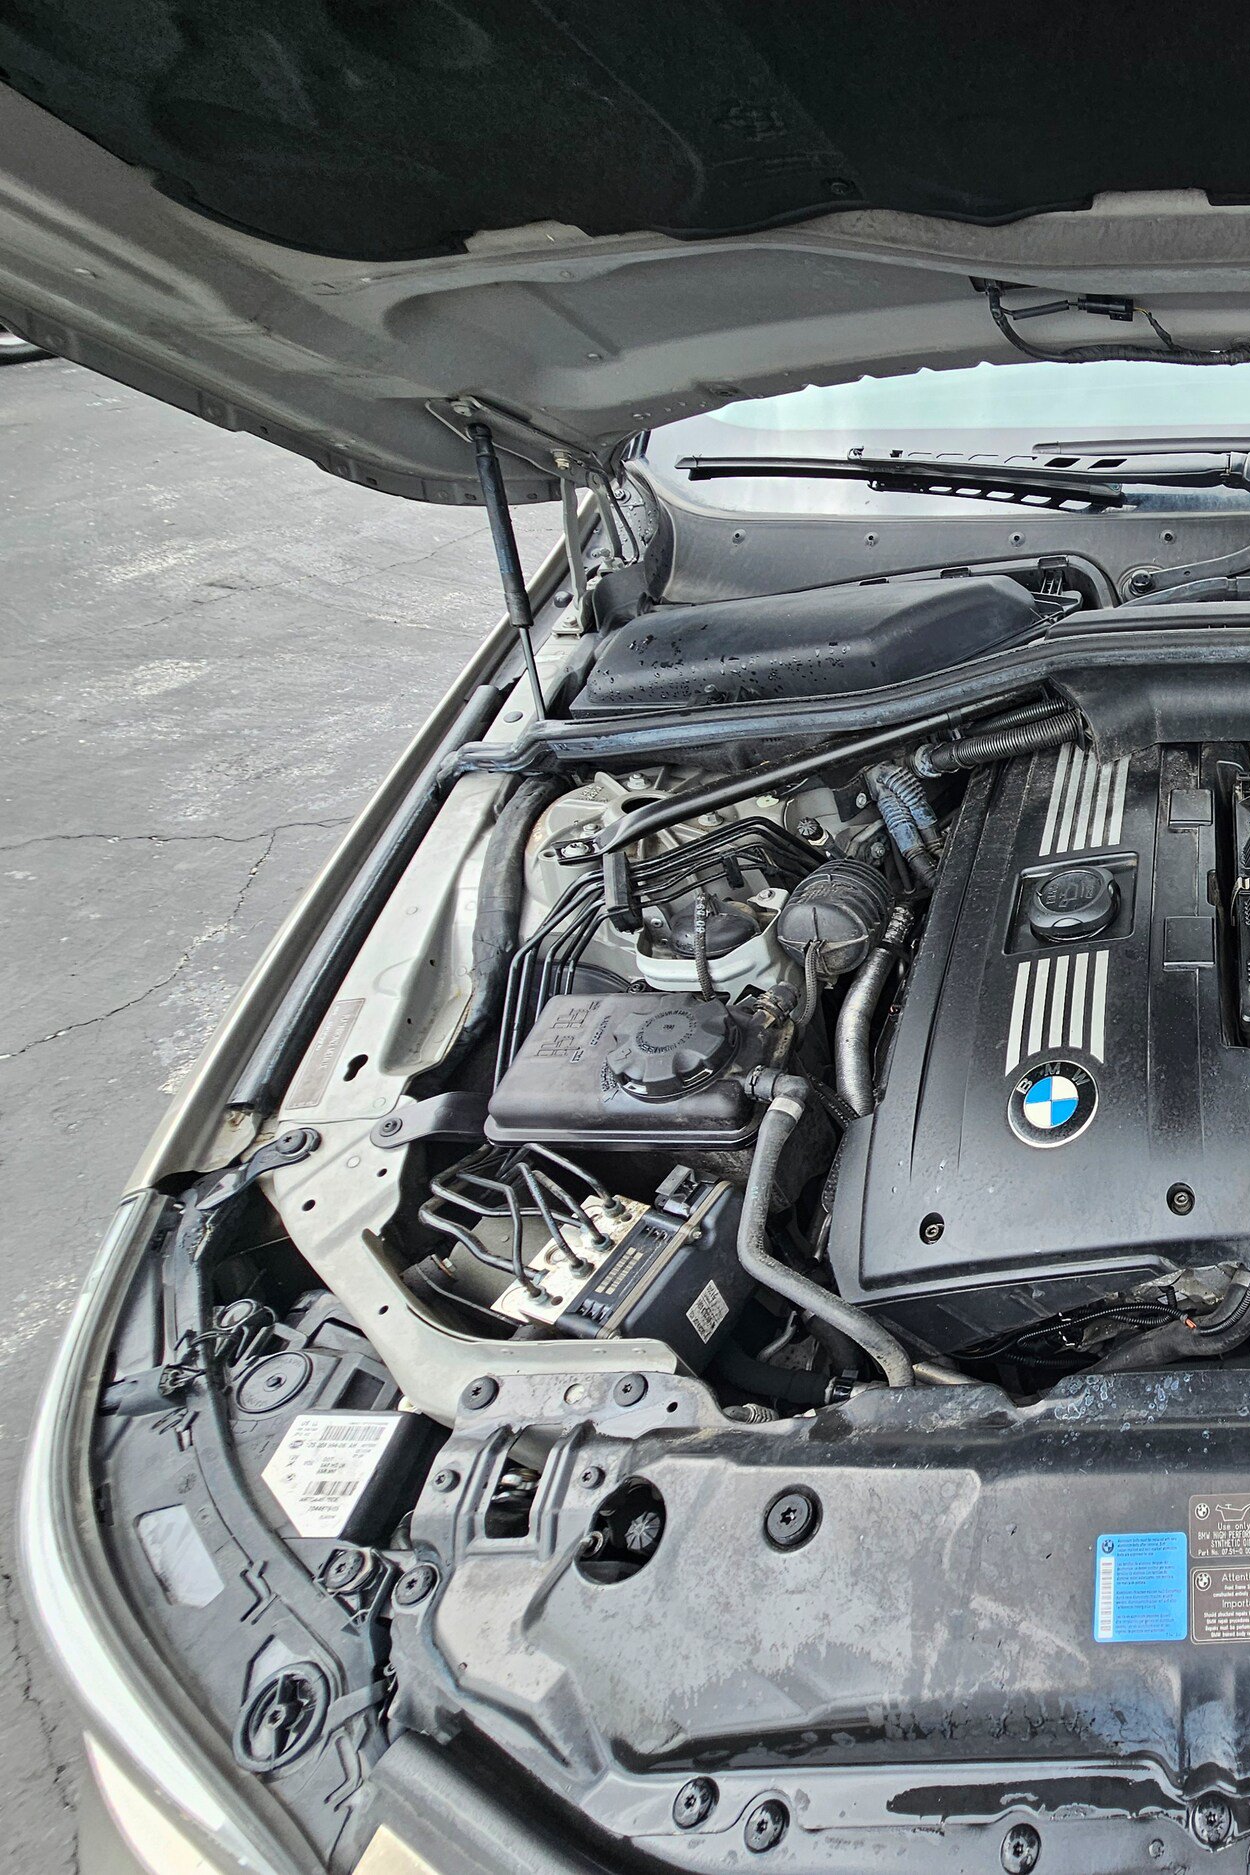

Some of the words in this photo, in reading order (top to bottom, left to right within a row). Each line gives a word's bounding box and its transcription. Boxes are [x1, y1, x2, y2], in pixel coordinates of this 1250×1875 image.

[1016, 1063, 1090, 1095] BMW
[1235, 1521, 1250, 1531] only
[1198, 1532, 1210, 1540] BMW
[1213, 1531, 1226, 1539] HIGH
[1211, 1539, 1240, 1547] SYNTHETIC
